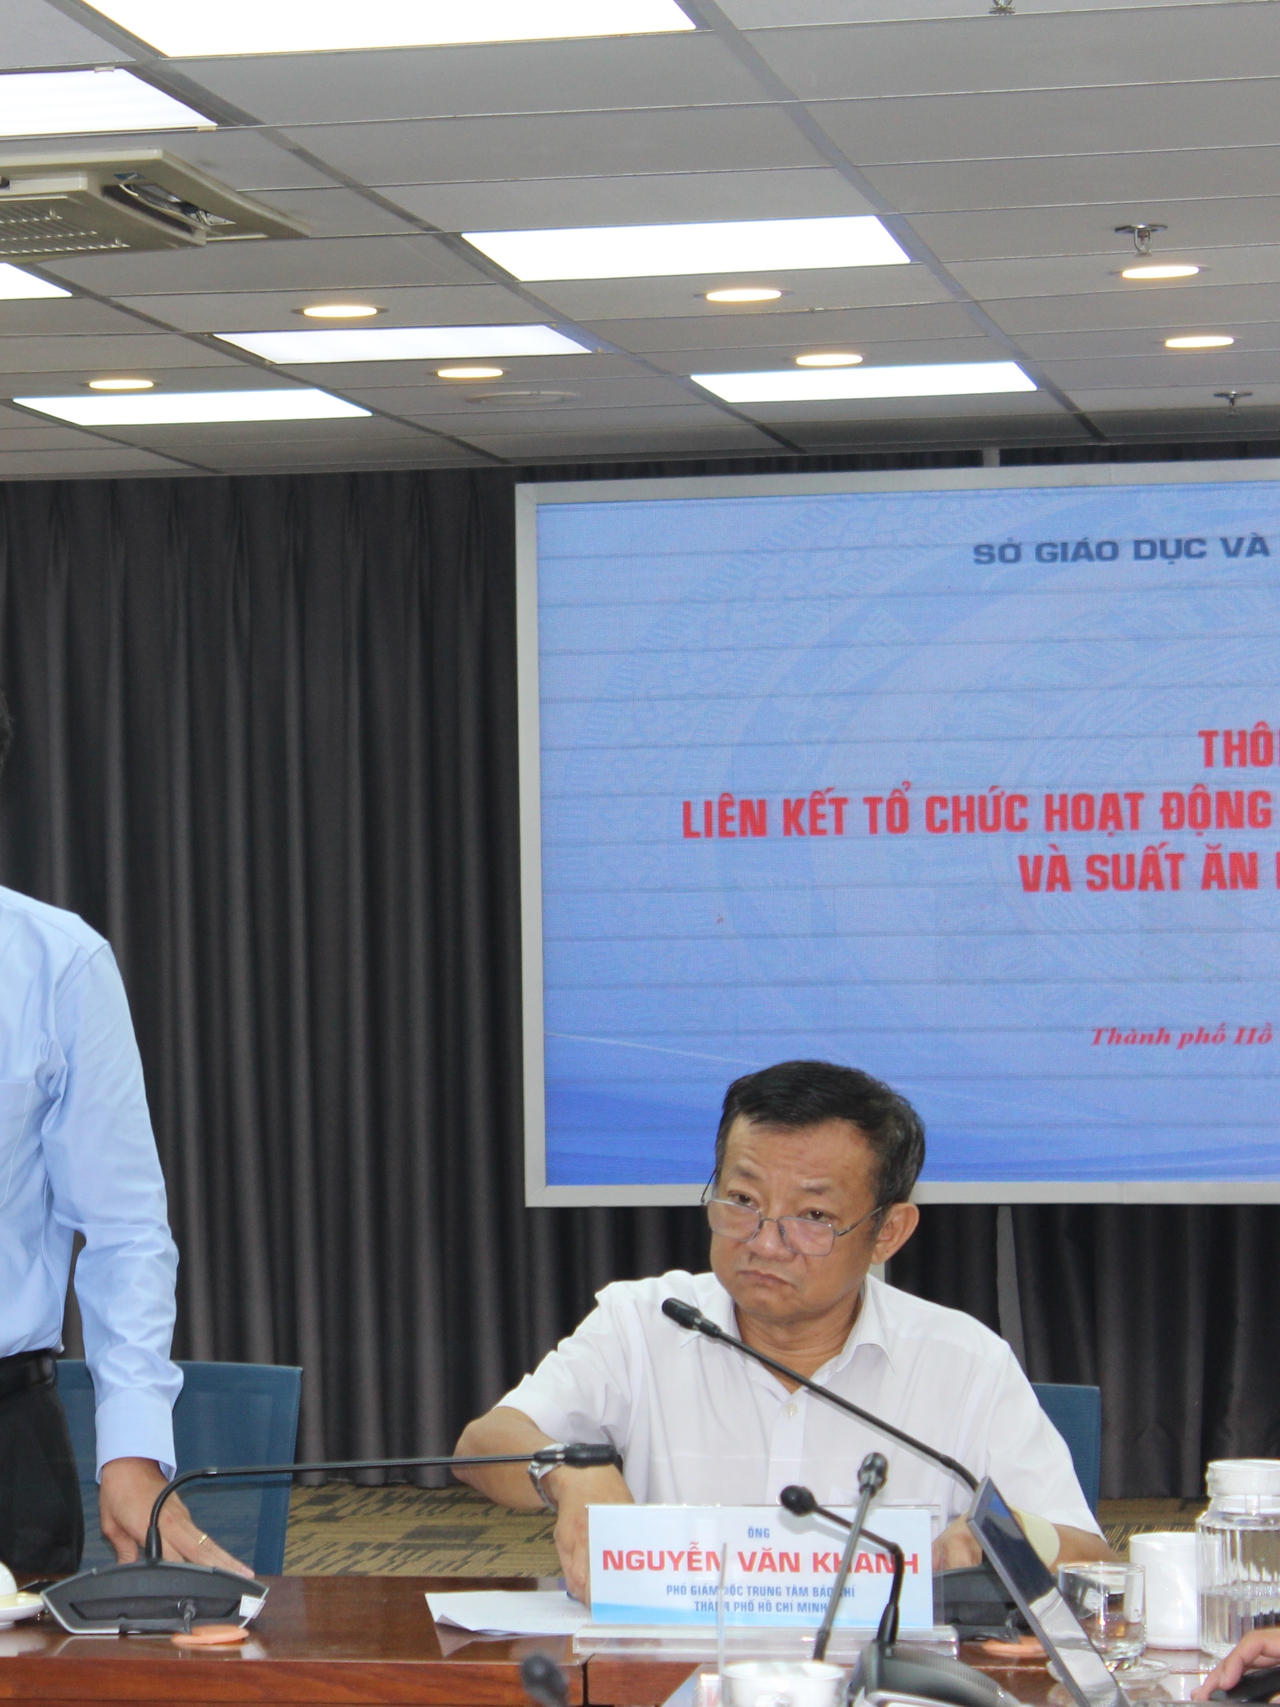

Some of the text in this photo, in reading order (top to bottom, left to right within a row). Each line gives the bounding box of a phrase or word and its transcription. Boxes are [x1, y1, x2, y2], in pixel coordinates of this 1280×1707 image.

[973, 532, 1271, 565] SỞ GIÁO DỤC VÀ
[1198, 720, 1280, 768] THÔ
[682, 780, 1272, 839] LIÊN KẾT TỔ CHỨC HOẠT ĐỘNG
[1018, 843, 1072, 892] VÀ
[1086, 841, 1185, 892] SUẤT
[1201, 843, 1259, 891] ĂN
[1091, 1027, 1171, 1046] Thành
[1176, 1022, 1227, 1050] phố
[748, 1526, 770, 1538] ÔNG
[602, 1541, 721, 1572] NGUYỄN
[737, 1547, 801, 1573] VĂN
[666, 1583, 687, 1596] PHÓ
[690, 1583, 718, 1596] GIÁM
[747, 1585, 782, 1597] TRUNG
[786, 1584, 809, 1597] TÂM
[838, 1584, 856, 1598] HÍ
[733, 1599, 754, 1612] PHỐ
[758, 1599, 771, 1612] HỒ
[776, 1600, 793, 1612] CHÍ
[797, 1602, 827, 1613] MINH
